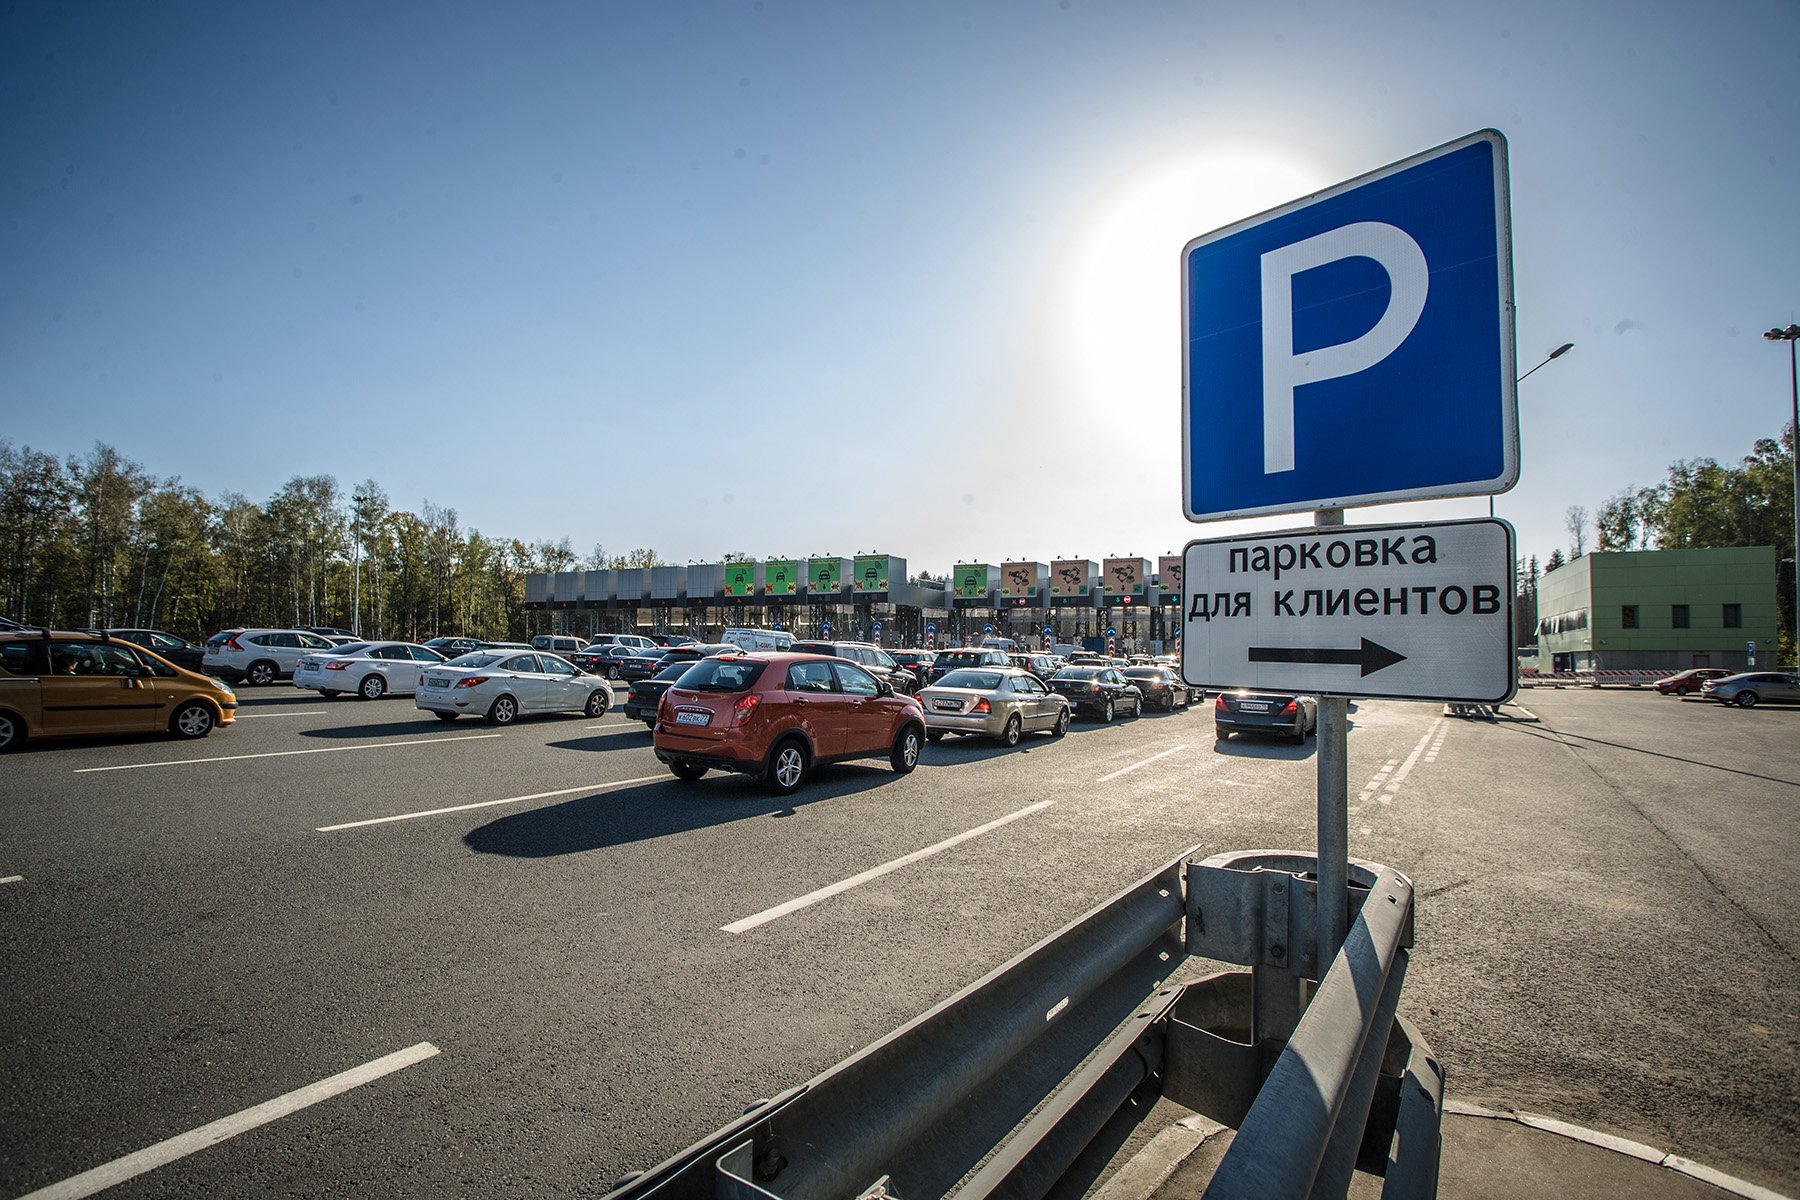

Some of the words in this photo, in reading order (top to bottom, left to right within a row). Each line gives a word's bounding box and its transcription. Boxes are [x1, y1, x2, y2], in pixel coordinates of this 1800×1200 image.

[1261, 221, 1429, 474] P
[1229, 534, 1438, 581] парковка
[1188, 591, 1251, 622] для
[1274, 584, 1501, 617] клиентов
